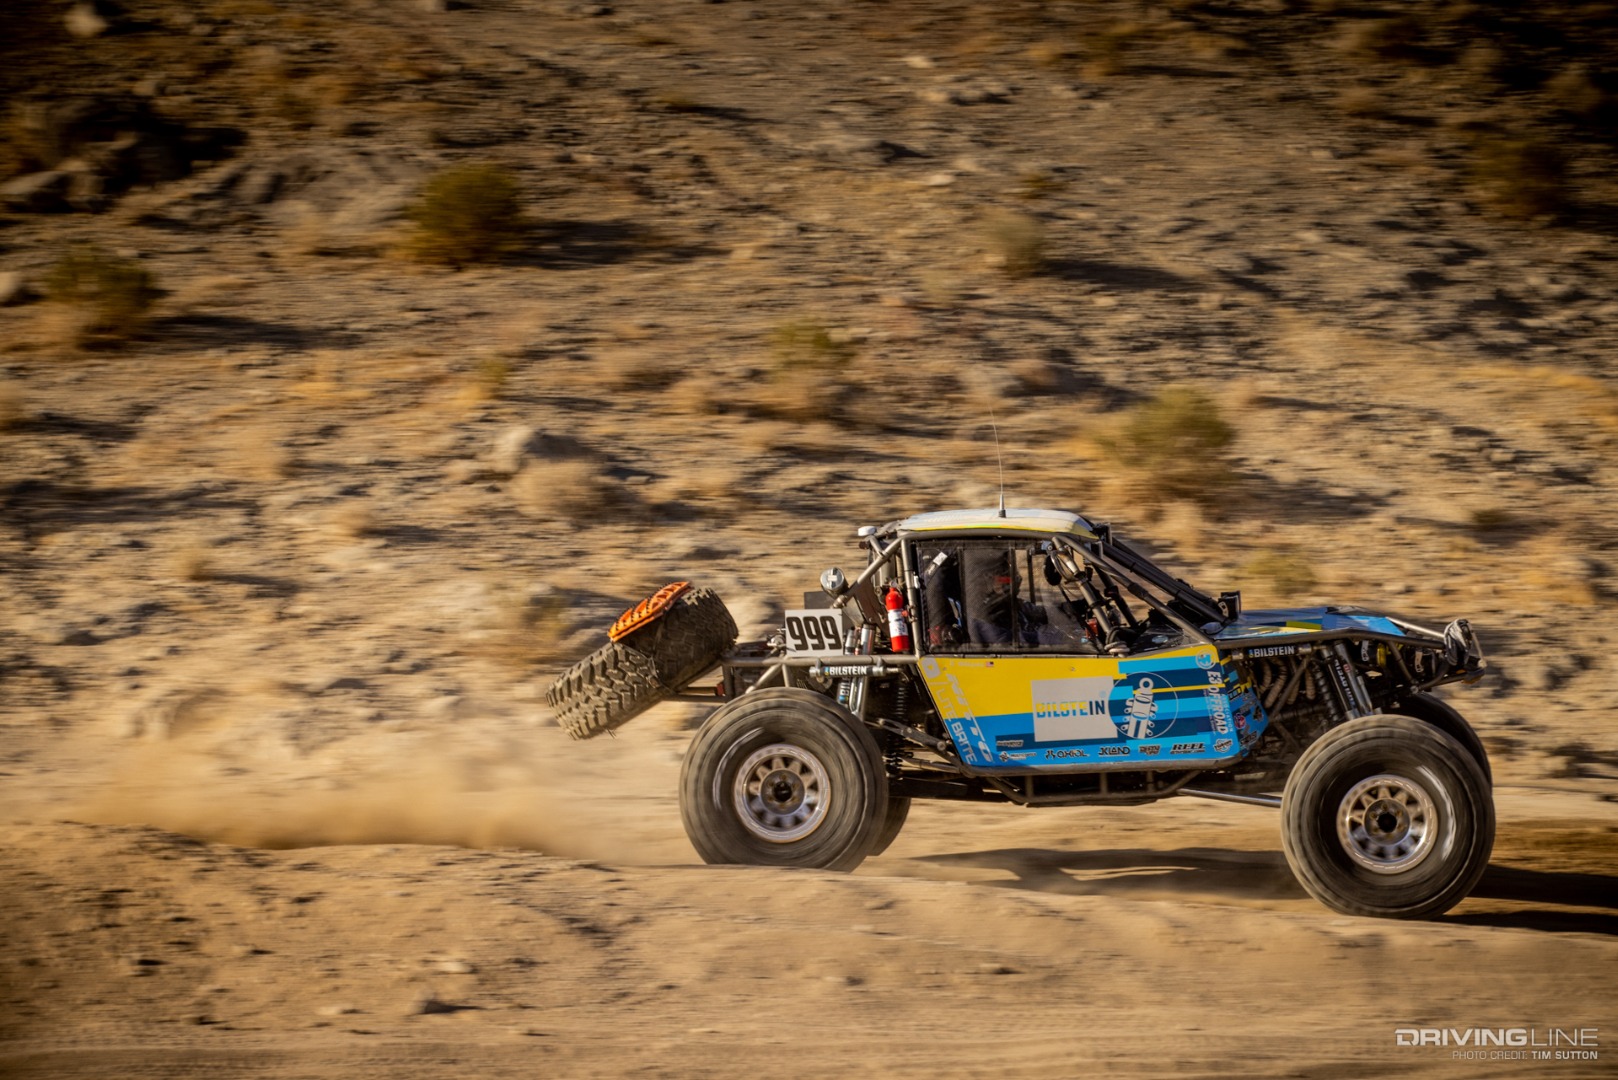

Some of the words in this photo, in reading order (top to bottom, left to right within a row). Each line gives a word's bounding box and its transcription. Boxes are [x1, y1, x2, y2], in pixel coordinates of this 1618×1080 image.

[786, 615, 843, 651] 999
[1254, 645, 1295, 658] BILSTEIN
[829, 665, 868, 676] BILSTEIN
[1207, 670, 1223, 685] E3
[1034, 699, 1106, 718] BILSTEIN
[1207, 685, 1229, 735] OFFROAD
[1171, 742, 1206, 751] REEL
